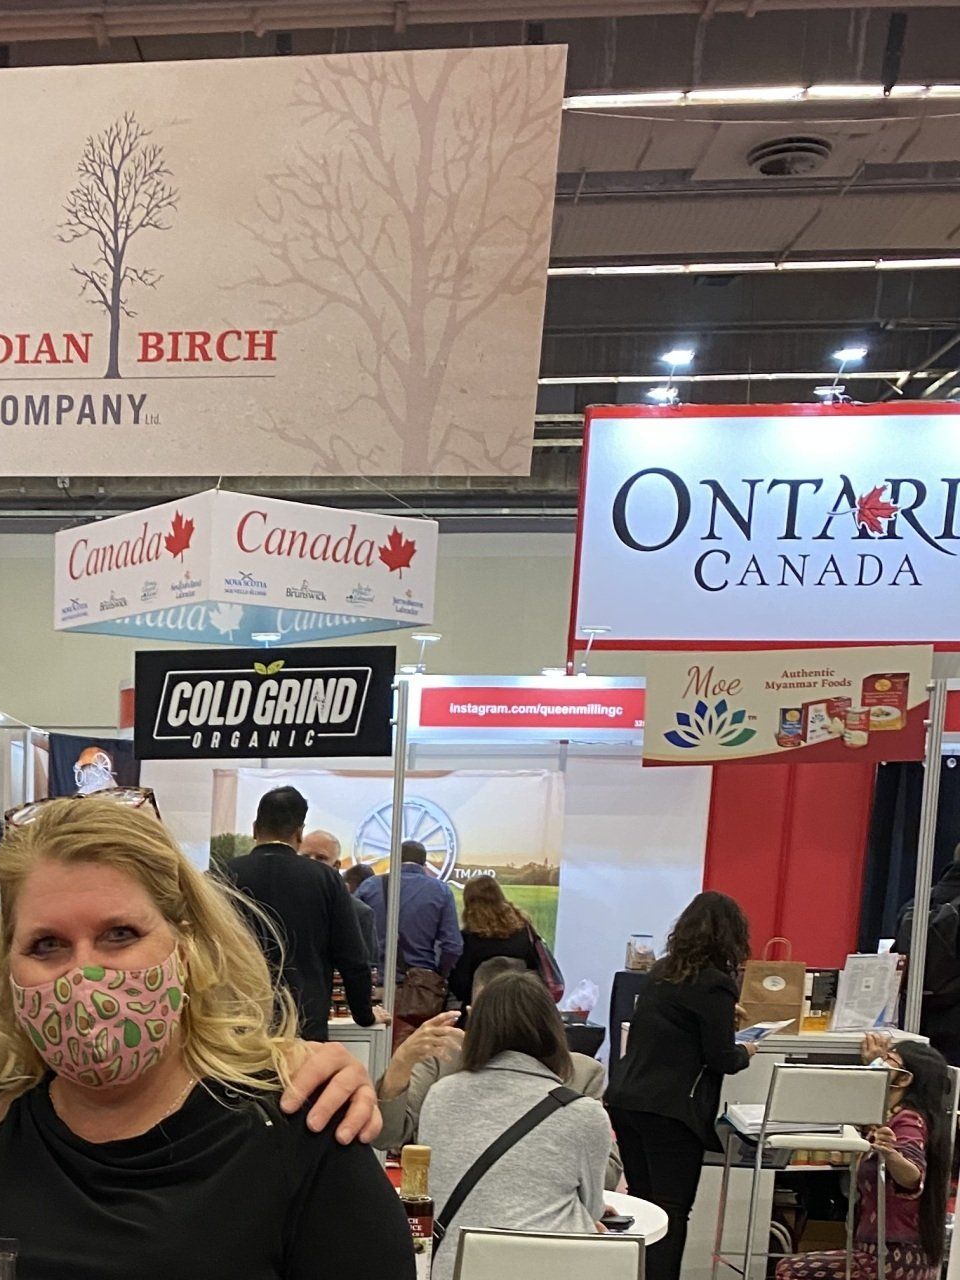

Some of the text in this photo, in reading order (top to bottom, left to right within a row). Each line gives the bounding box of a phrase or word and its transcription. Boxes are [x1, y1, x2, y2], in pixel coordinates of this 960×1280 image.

[138, 330, 278, 362] BIRCH
[69, 522, 162, 580] Canada
[237, 510, 375, 567] Canada
[694, 549, 923, 592] CANADA
[682, 665, 744, 700] Moe
[764, 678, 852, 691] Myanmar Foods
[780, 668, 836, 679] Authentic
[167, 678, 358, 727] COLD GRIND
[192, 729, 315, 749] ORGANIC
